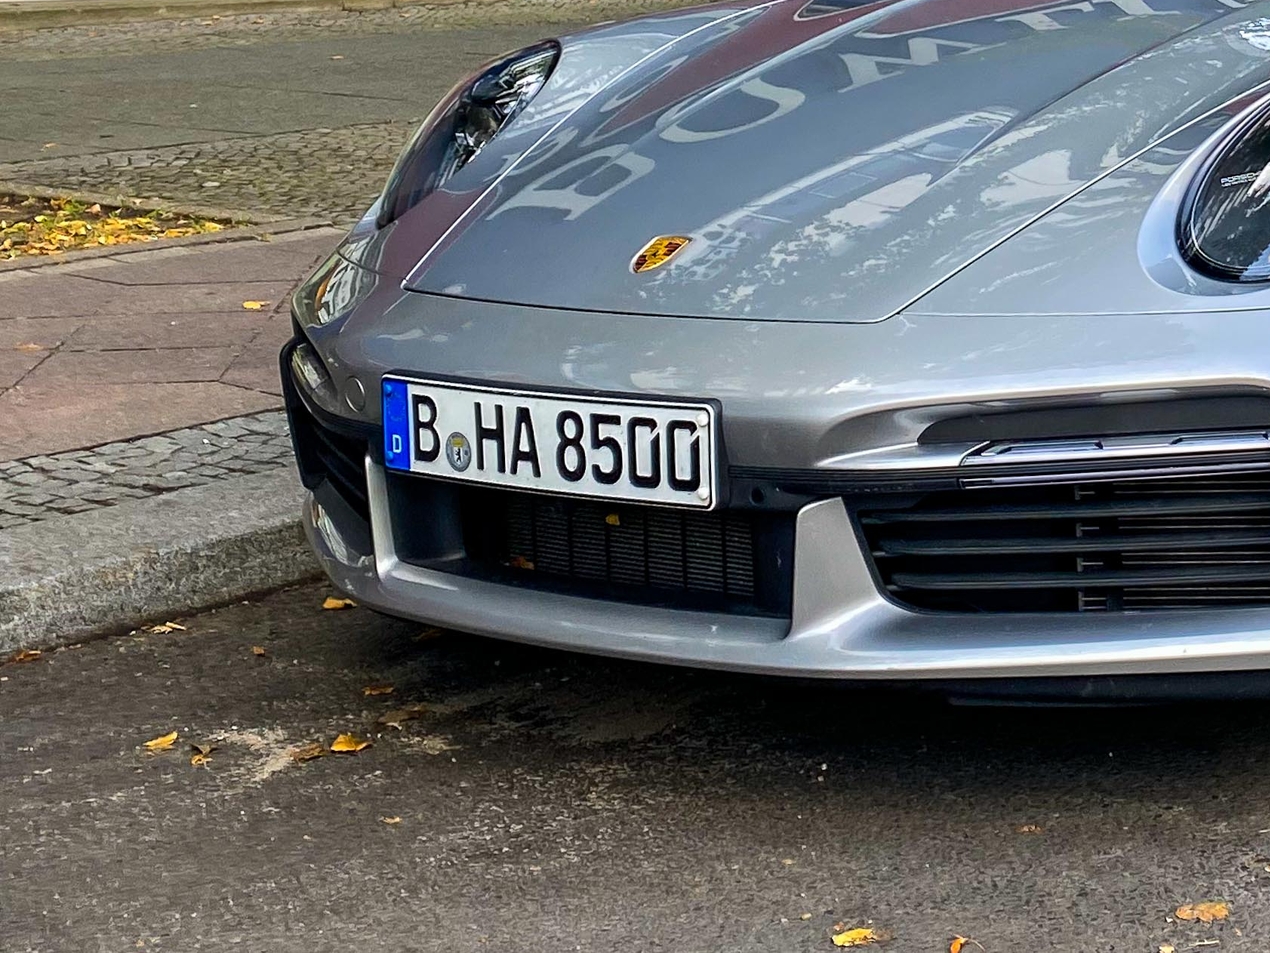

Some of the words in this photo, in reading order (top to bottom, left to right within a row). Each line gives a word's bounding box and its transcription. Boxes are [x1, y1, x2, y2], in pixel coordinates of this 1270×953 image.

[392, 434, 401, 453] D
[411, 393, 440, 463] B
[474, 401, 541, 478] HA
[556, 410, 700, 492] 8500
